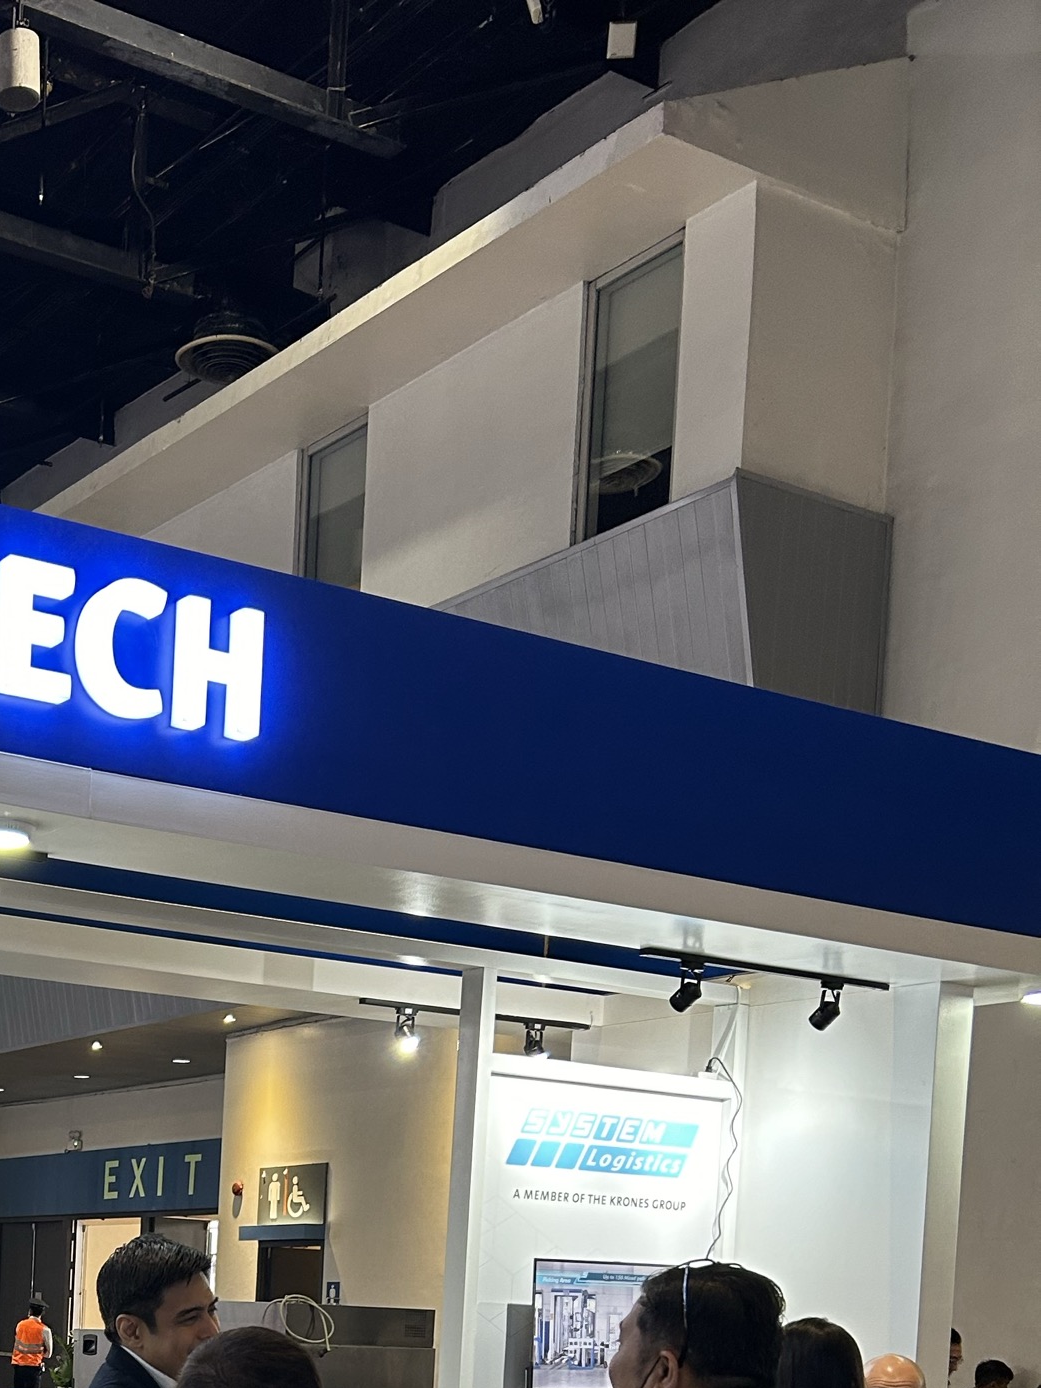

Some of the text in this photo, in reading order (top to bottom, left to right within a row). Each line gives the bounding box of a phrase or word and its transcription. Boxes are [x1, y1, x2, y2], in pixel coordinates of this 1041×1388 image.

[523, 1109, 668, 1145] SYSTEM
[102, 1153, 203, 1200] EXIT
[585, 1148, 683, 1174] Logistics
[513, 1188, 687, 1211] A MEMBER OF THE KRONES GROUP
